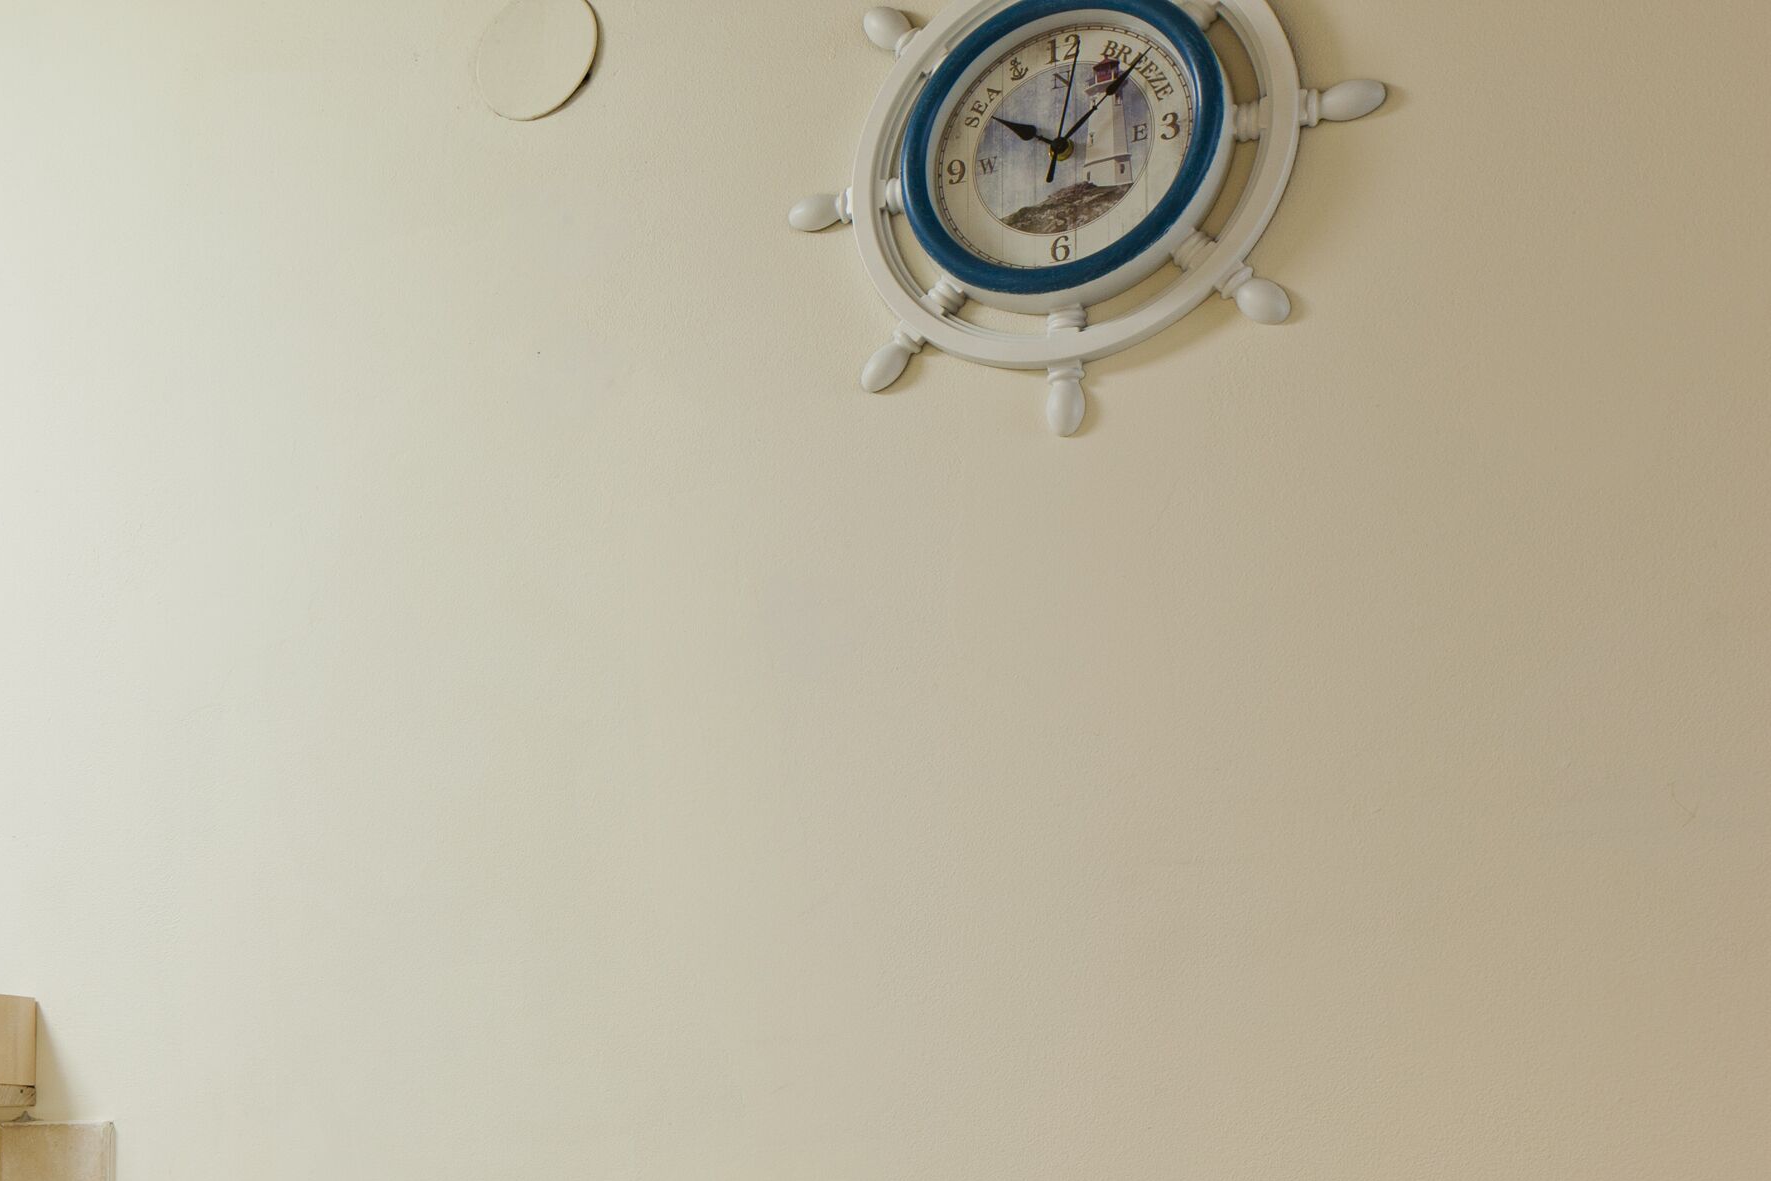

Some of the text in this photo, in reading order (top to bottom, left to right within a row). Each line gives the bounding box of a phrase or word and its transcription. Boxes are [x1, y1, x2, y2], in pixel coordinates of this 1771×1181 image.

[1045, 33, 1080, 65] 12
[1052, 70, 1072, 90] N
[1100, 40, 1173, 101] BREEZE
[965, 86, 1002, 128] SEA
[1131, 123, 1148, 144] E
[1161, 111, 1181, 141] 3
[946, 159, 967, 185] 9
[978, 156, 998, 176] W
[1049, 235, 1072, 263] 6
